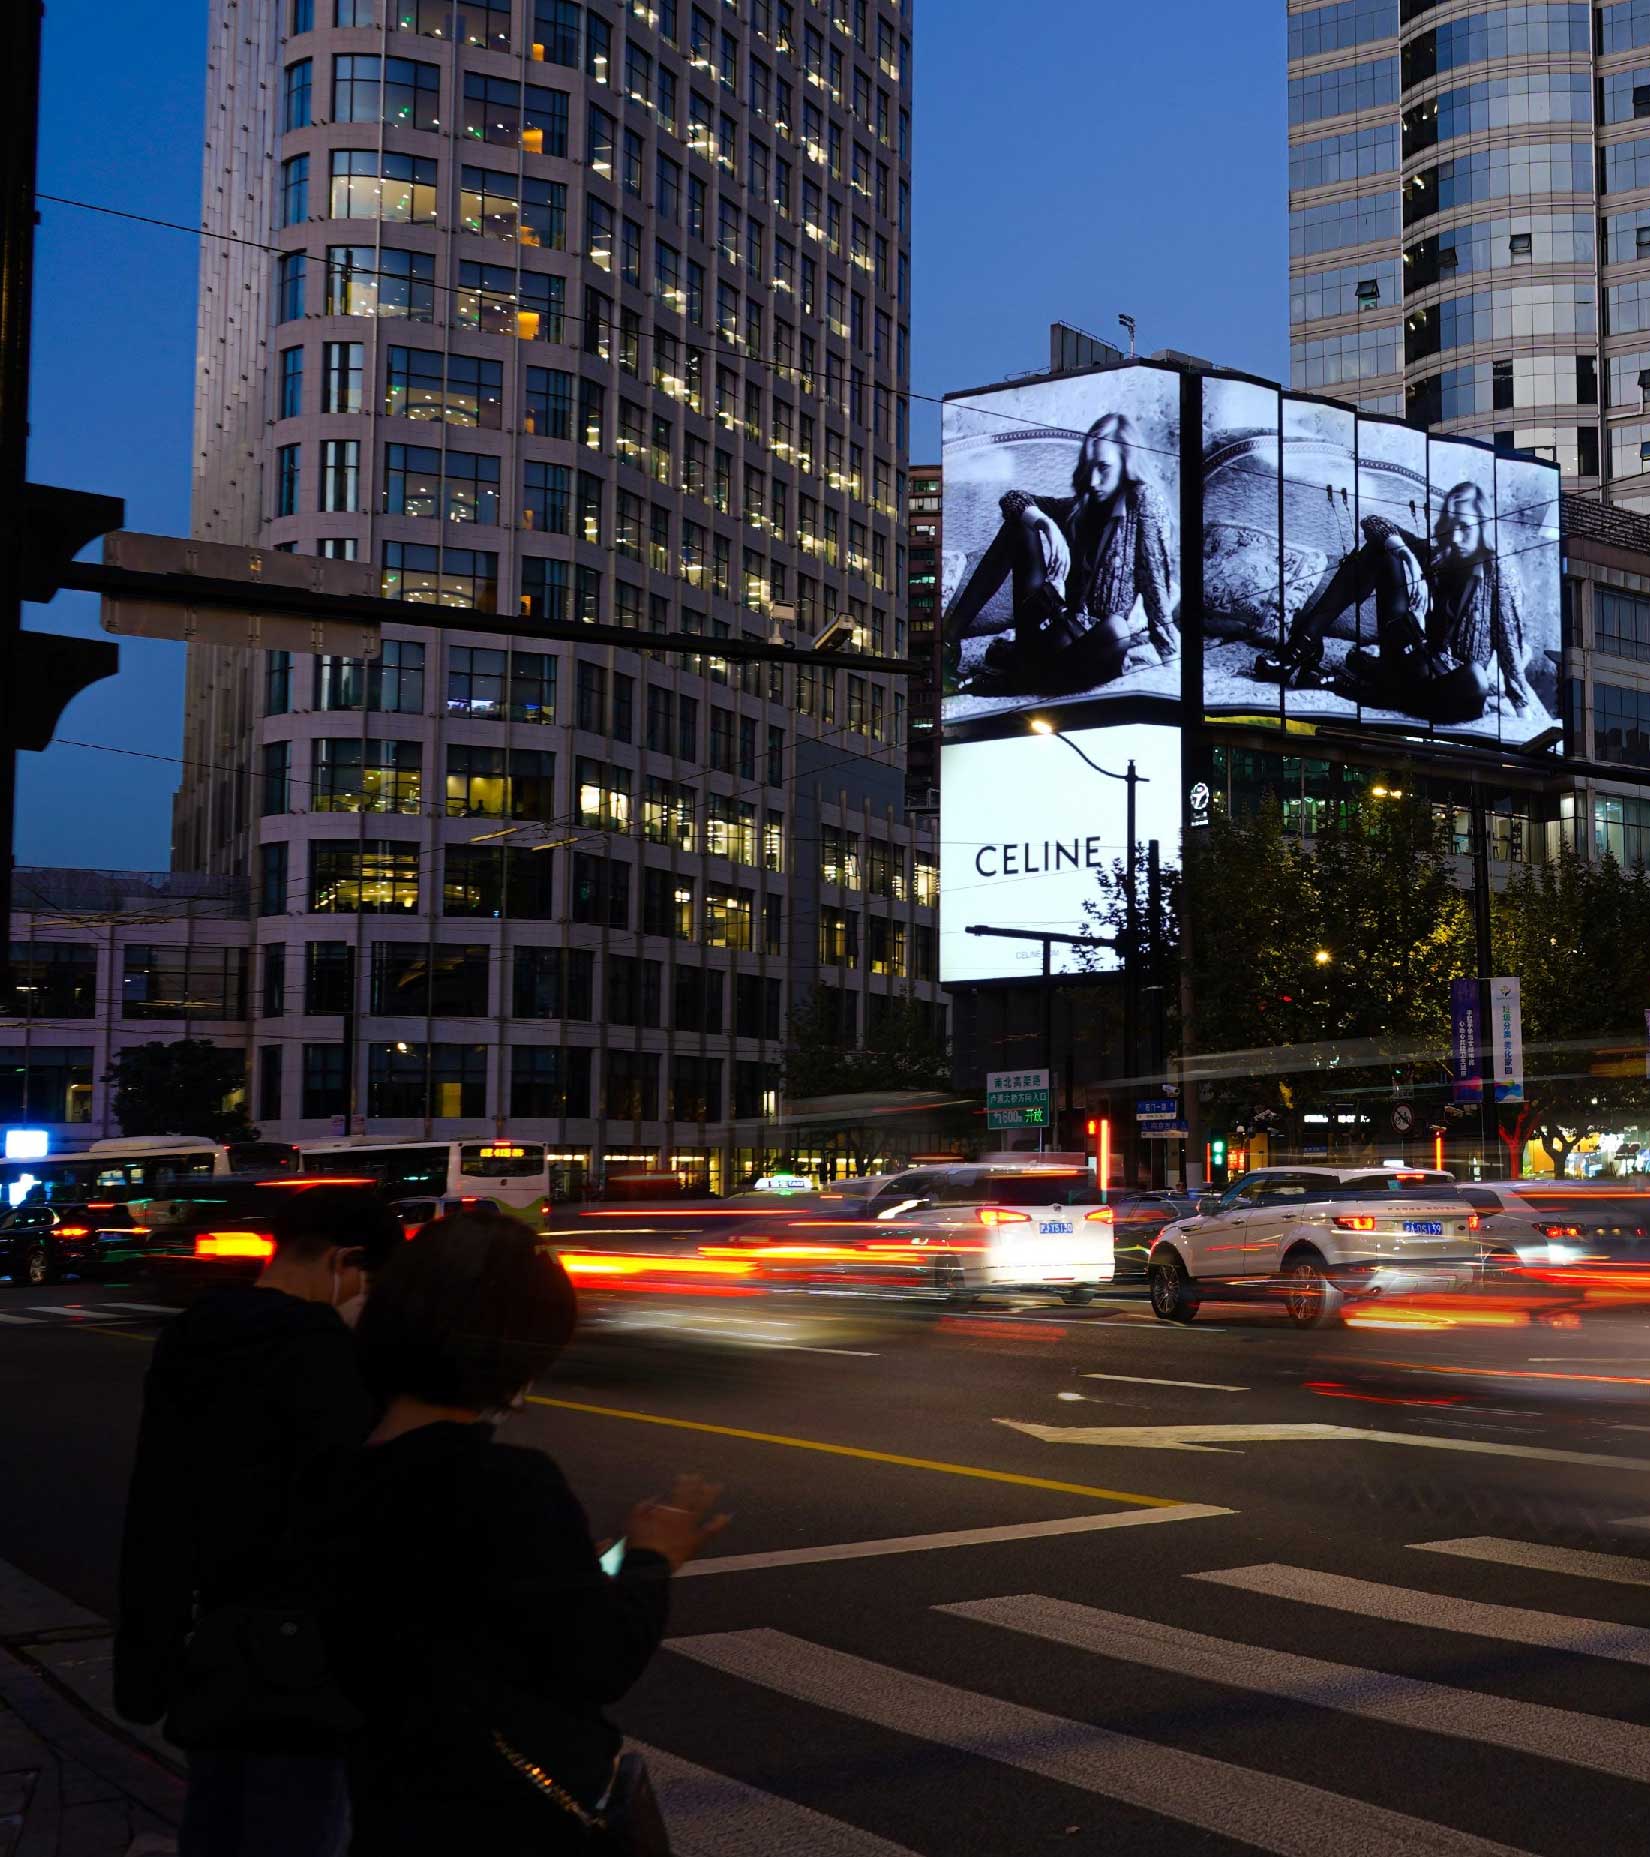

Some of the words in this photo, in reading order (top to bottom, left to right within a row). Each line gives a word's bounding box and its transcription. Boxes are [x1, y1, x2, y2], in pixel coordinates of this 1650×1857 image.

[975, 834, 1103, 879] CELINE
[994, 1074, 1041, 1088] 南北高架路
[1024, 1108, 1044, 1123] 开放
